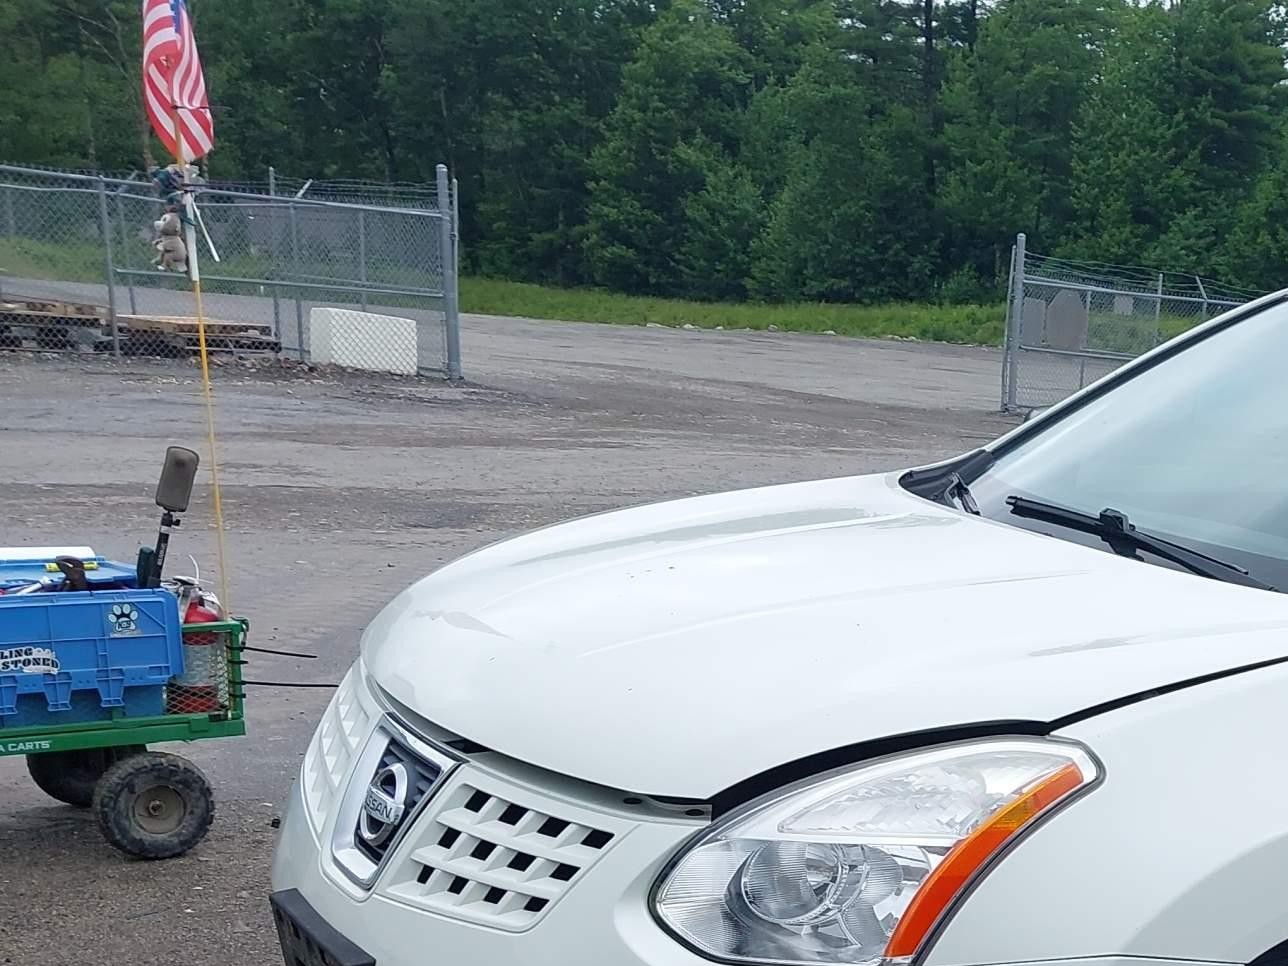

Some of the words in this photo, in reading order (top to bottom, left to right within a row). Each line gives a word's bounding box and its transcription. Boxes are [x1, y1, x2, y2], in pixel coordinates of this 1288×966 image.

[0, 647, 33, 660] LING
[1, 657, 59, 670] STONED
[8, 740, 50, 752] CARTS
[367, 795, 392, 818] SSAN
